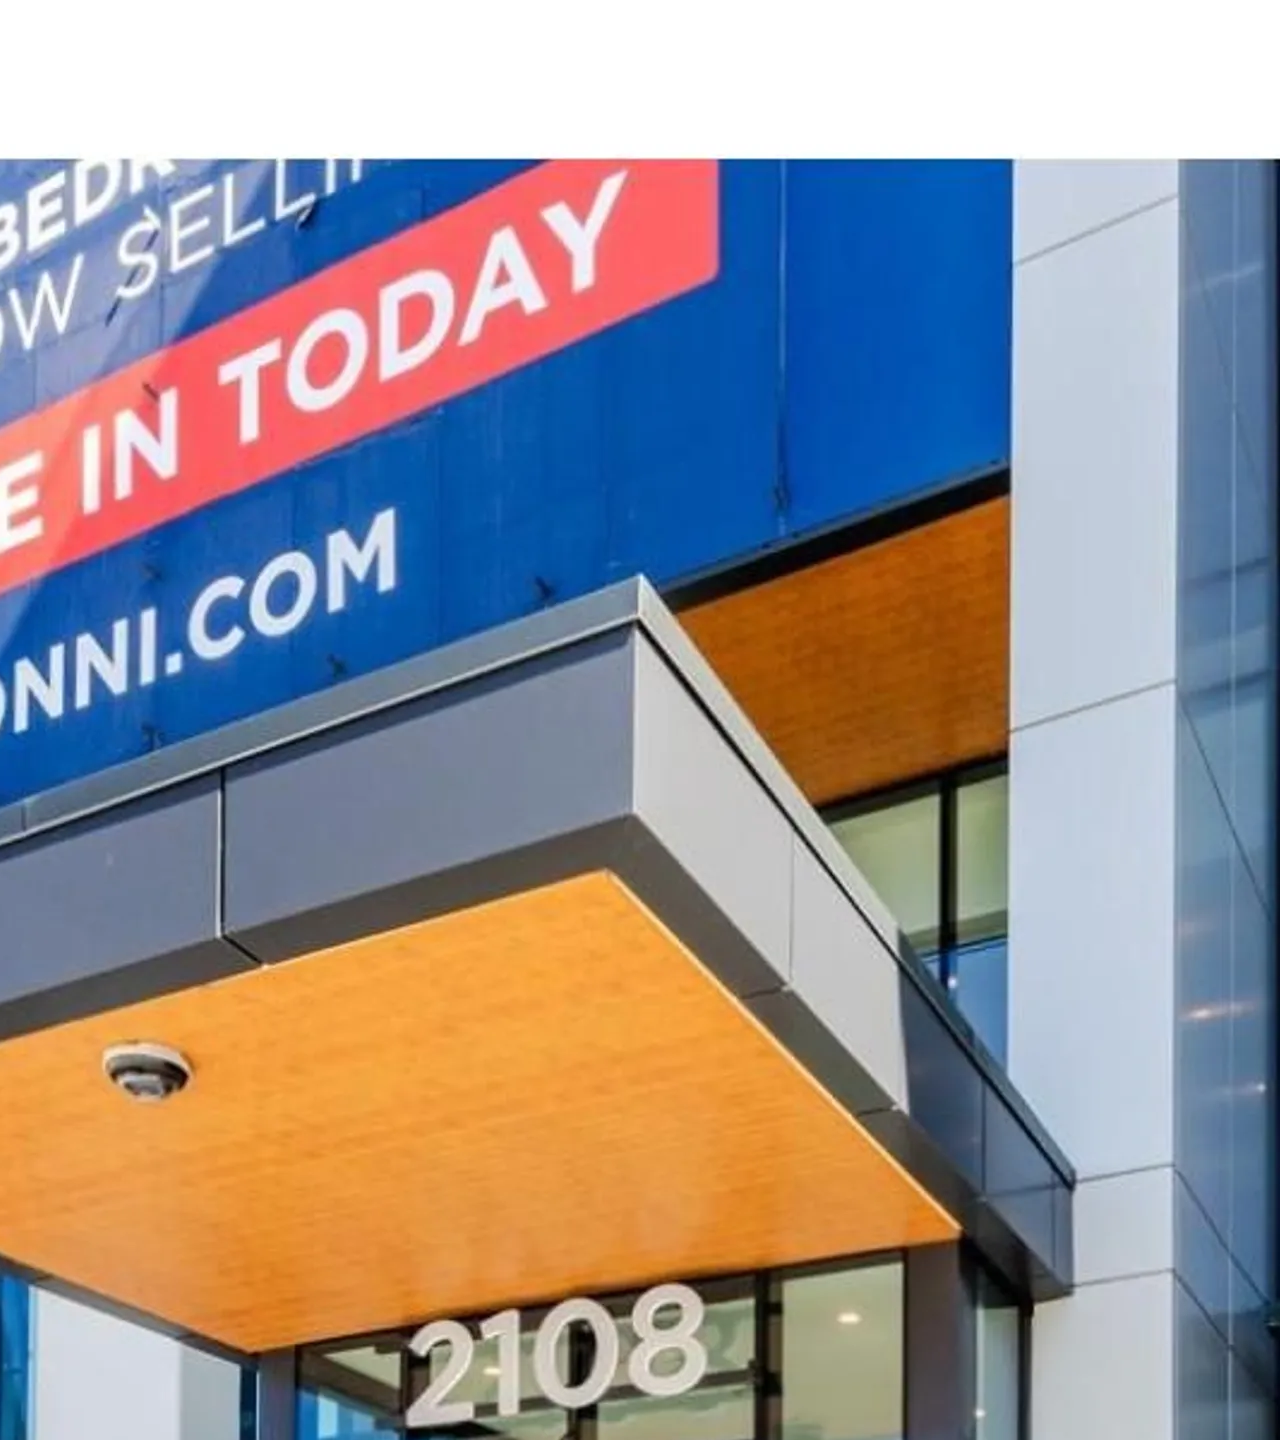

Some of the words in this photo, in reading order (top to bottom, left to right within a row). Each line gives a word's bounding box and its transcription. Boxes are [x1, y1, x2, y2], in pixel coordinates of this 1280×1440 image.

[81, 386, 178, 516] IN
[219, 169, 628, 444] TODAY
[405, 1283, 708, 1429] 2108
